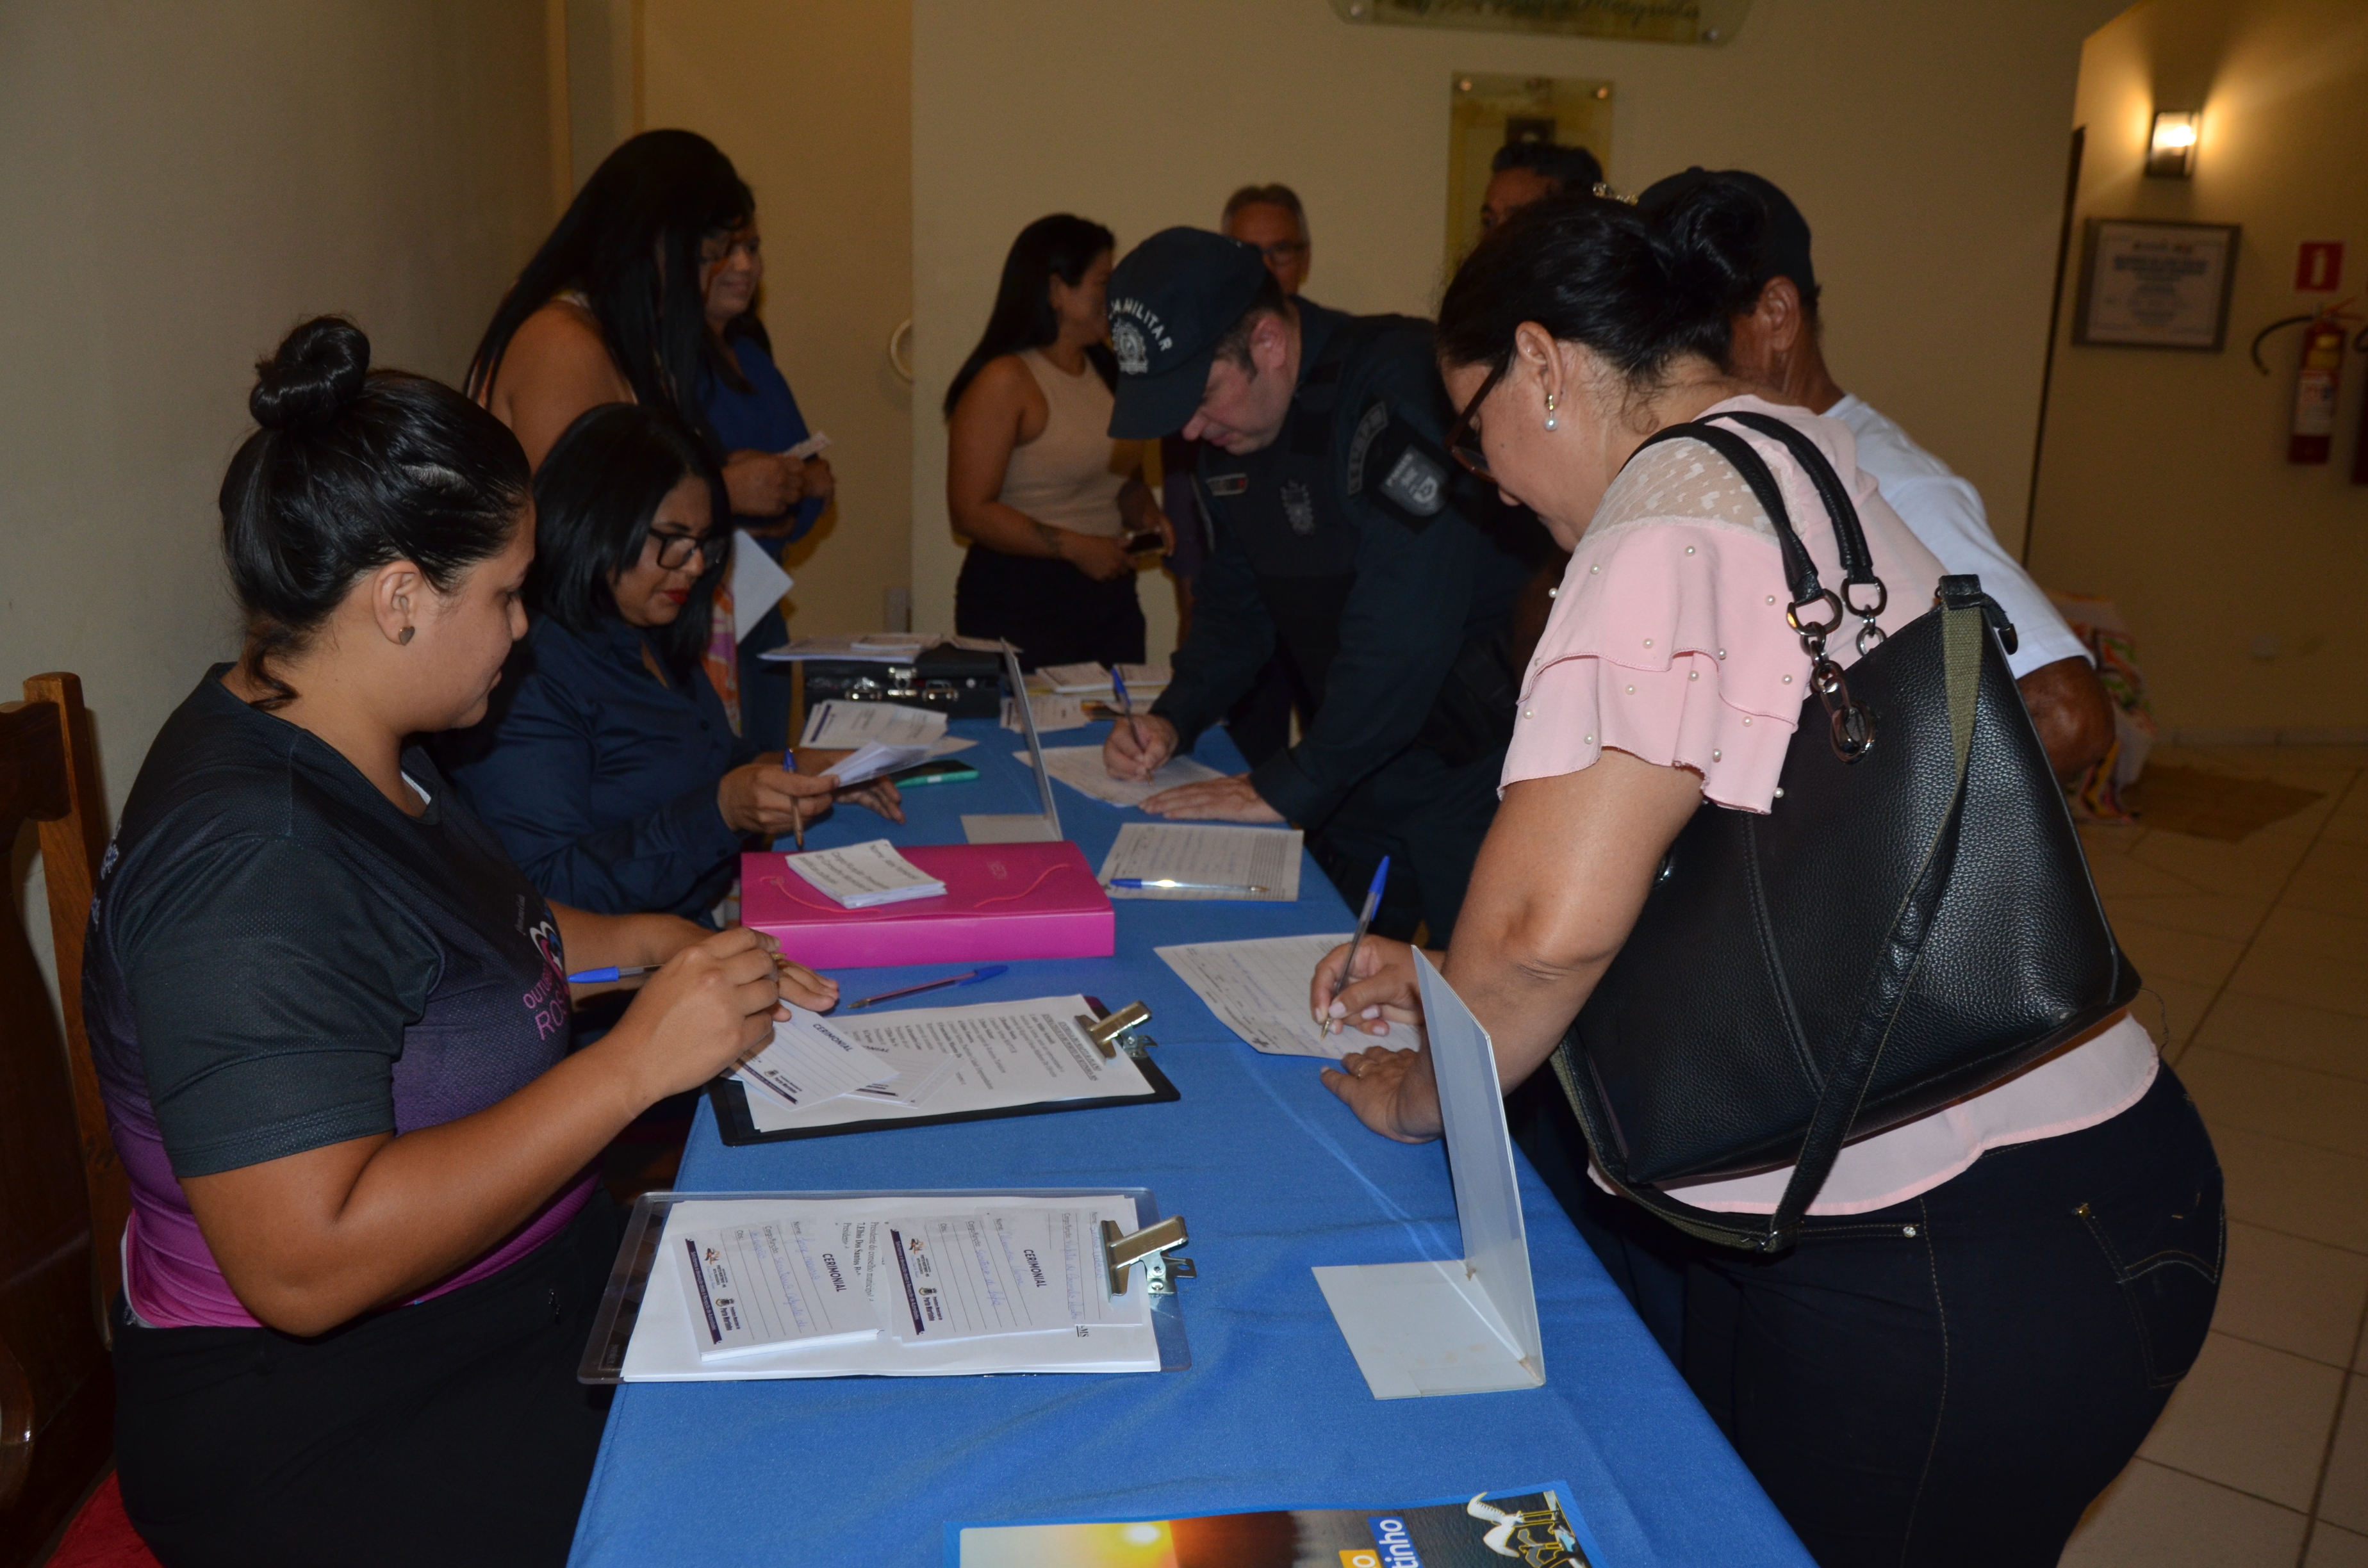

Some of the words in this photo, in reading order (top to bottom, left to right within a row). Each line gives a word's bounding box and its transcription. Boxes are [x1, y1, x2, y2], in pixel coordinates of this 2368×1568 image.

[1122, 298, 1172, 352] MILITAR
[812, 1023, 853, 1052] CERIMONIAL
[793, 1221, 802, 1234] Nome:
[855, 1222, 864, 1238] 7.Elbio
[869, 1221, 878, 1243] Presidente
[939, 1223, 948, 1232] Obs.:
[995, 1218, 1004, 1230] Nome:
[736, 1230, 745, 1241] Obs.:
[764, 1225, 780, 1254] Cargo/função:
[967, 1221, 982, 1247] Cargo/função:
[854, 1239, 862, 1248] Dos
[853, 1249, 862, 1265] Santos
[866, 1252, 876, 1271] conselho
[822, 1253, 847, 1292] CERIMONIAL
[1023, 1248, 1046, 1287] CERIMONIAL
[865, 1273, 873, 1296] municipal
[923, 1297, 932, 1306] Porto
[719, 1307, 728, 1316] Porto
[925, 1306, 935, 1321] Murtinho
[722, 1316, 733, 1331] Murtinho
[1078, 1326, 1089, 1337] -MS
[1379, 1519, 1418, 1568] tinho
